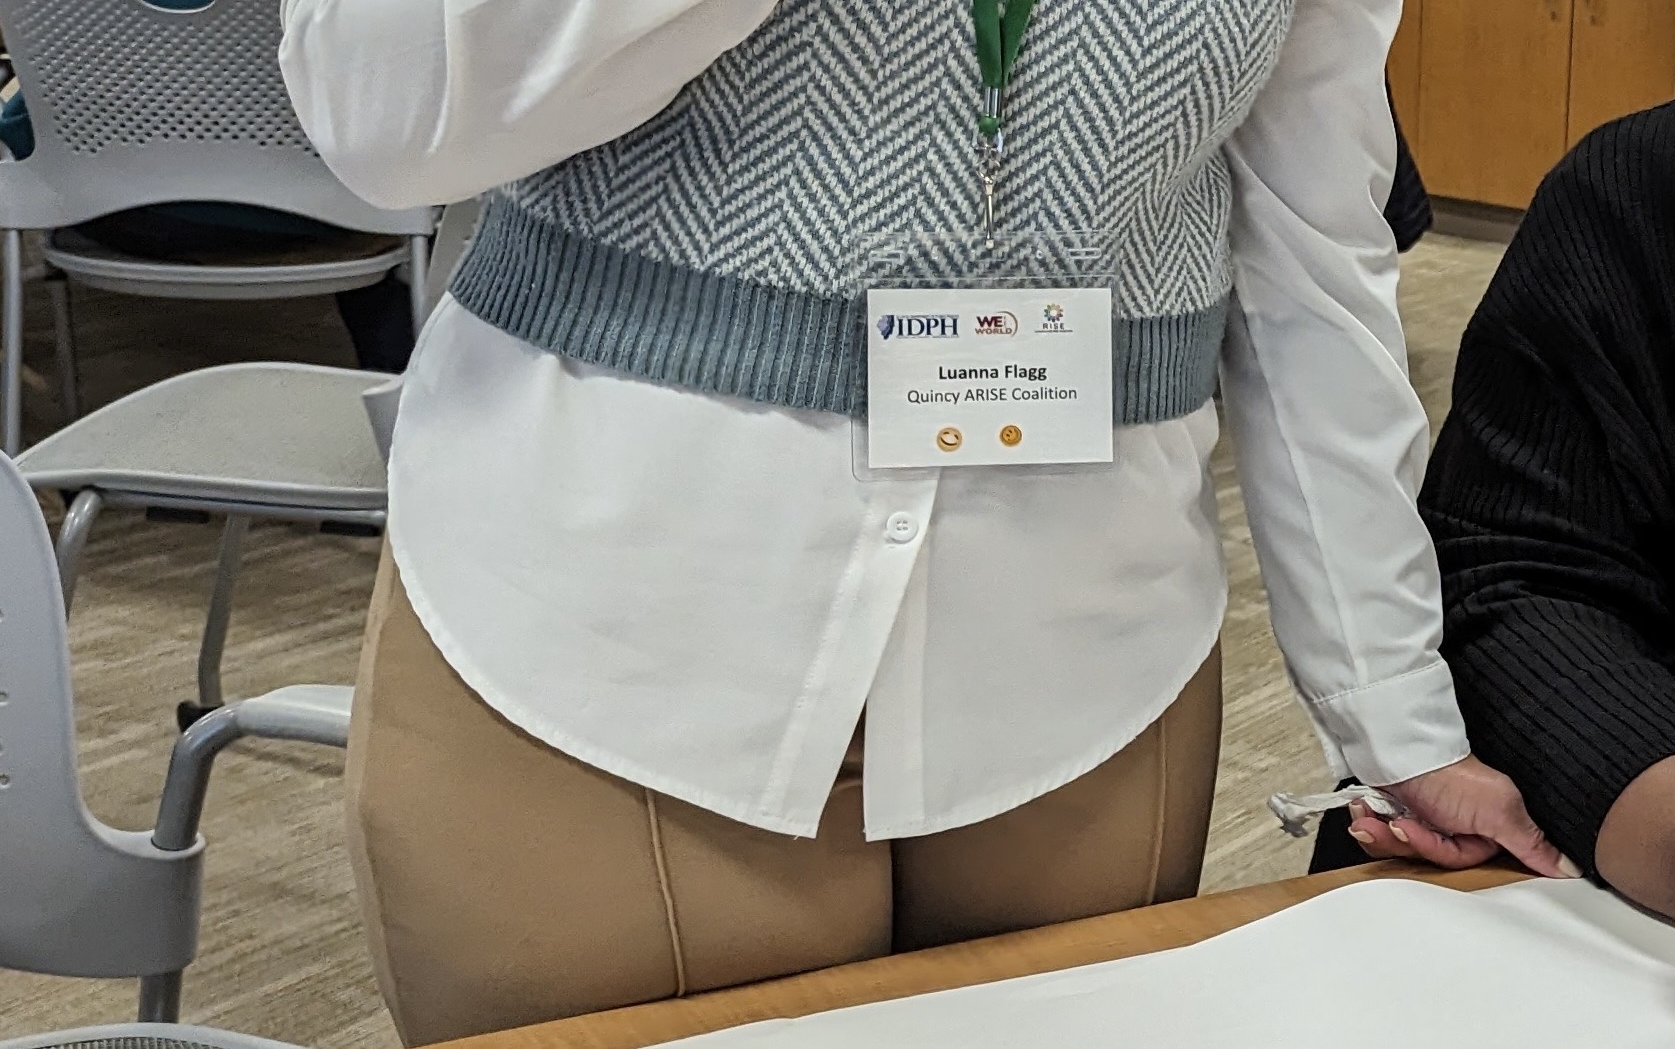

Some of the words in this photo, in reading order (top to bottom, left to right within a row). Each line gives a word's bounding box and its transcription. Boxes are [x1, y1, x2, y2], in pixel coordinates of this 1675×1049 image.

[897, 315, 959, 337] IDPH
[976, 316, 1003, 327] WE
[1042, 322, 1065, 330] RISE
[975, 327, 1012, 336] WORLD
[938, 365, 999, 380] Luanna
[1004, 364, 1048, 381] Flagg
[907, 388, 961, 404] Quincy
[964, 388, 1008, 401] ARISE
[1011, 386, 1077, 401] Coalition
